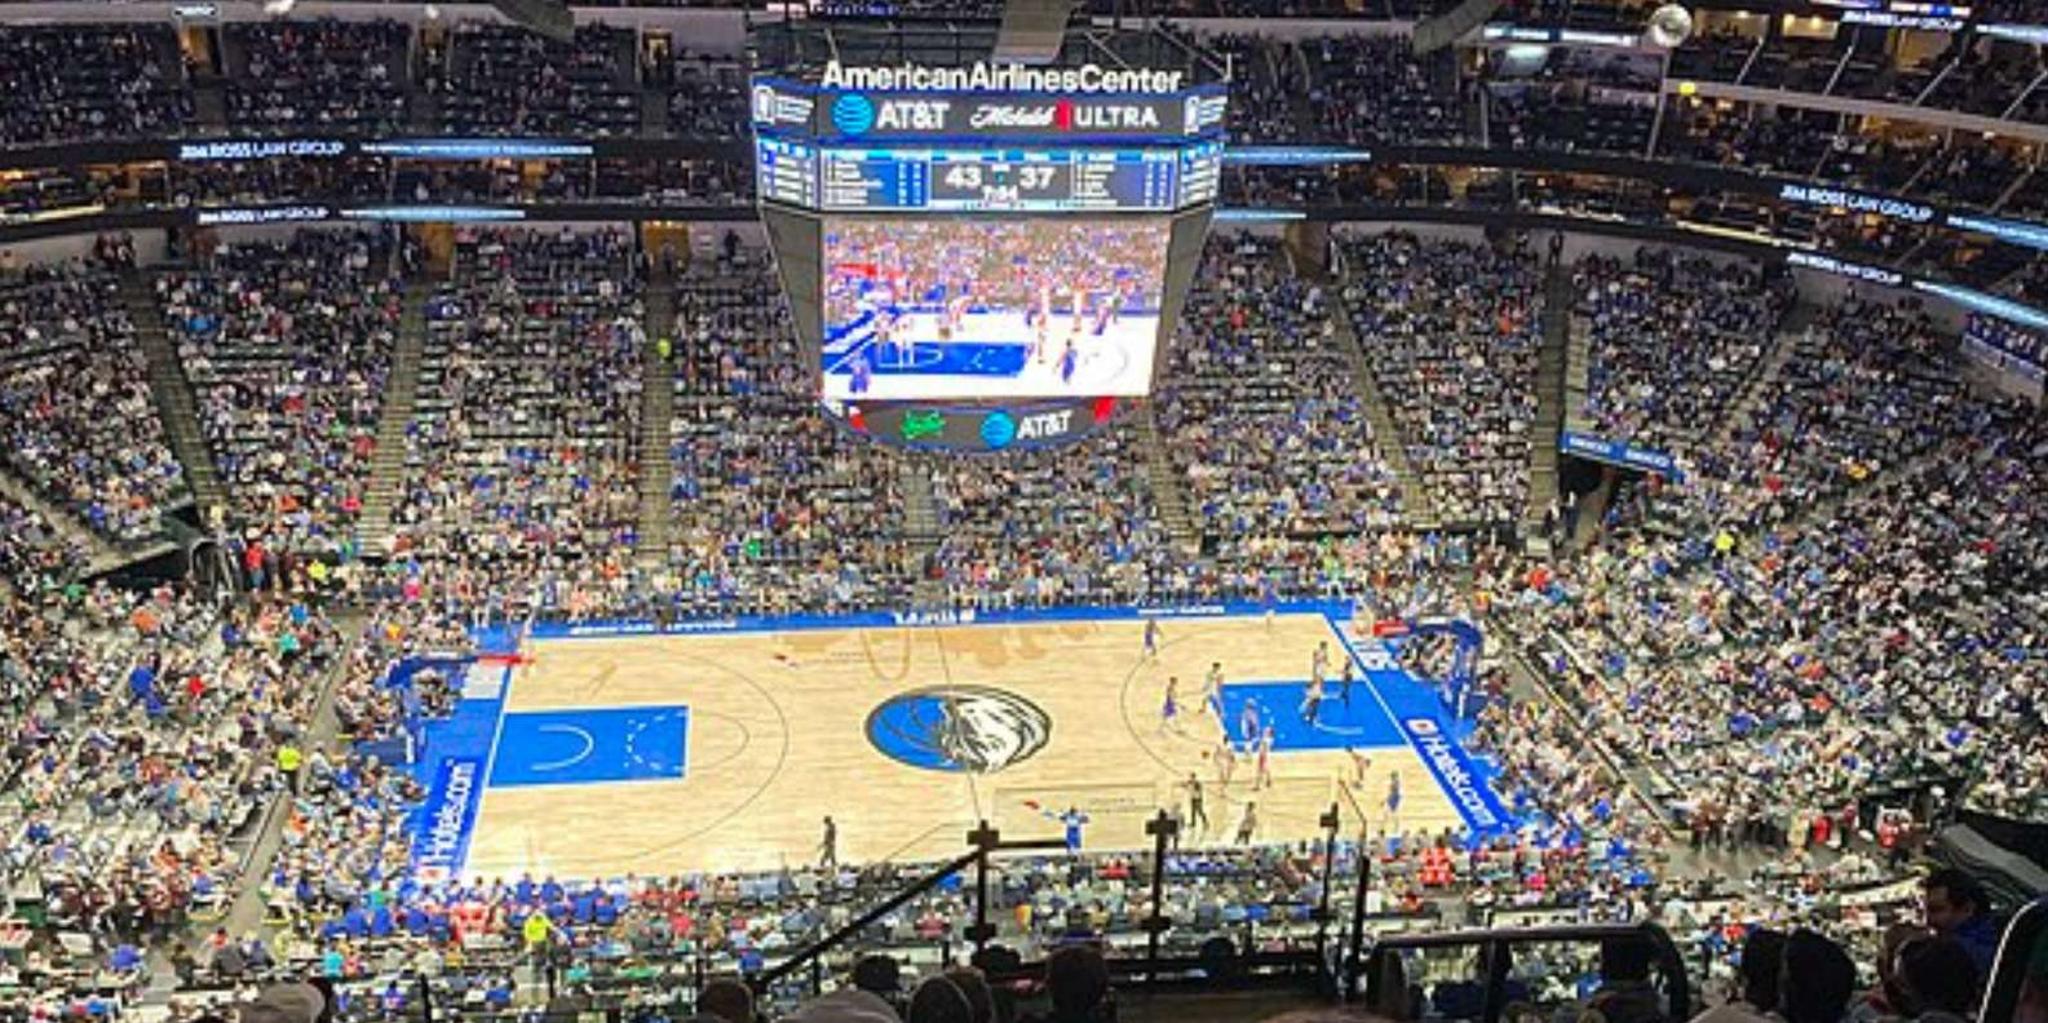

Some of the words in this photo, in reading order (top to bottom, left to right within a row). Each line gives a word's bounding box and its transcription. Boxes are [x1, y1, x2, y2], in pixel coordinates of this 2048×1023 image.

[877, 102, 949, 130] AT&T
[1074, 106, 1159, 128] ULTRA
[944, 165, 982, 188] 43
[1019, 166, 1055, 189] 37
[1017, 410, 1073, 440] AT&T
